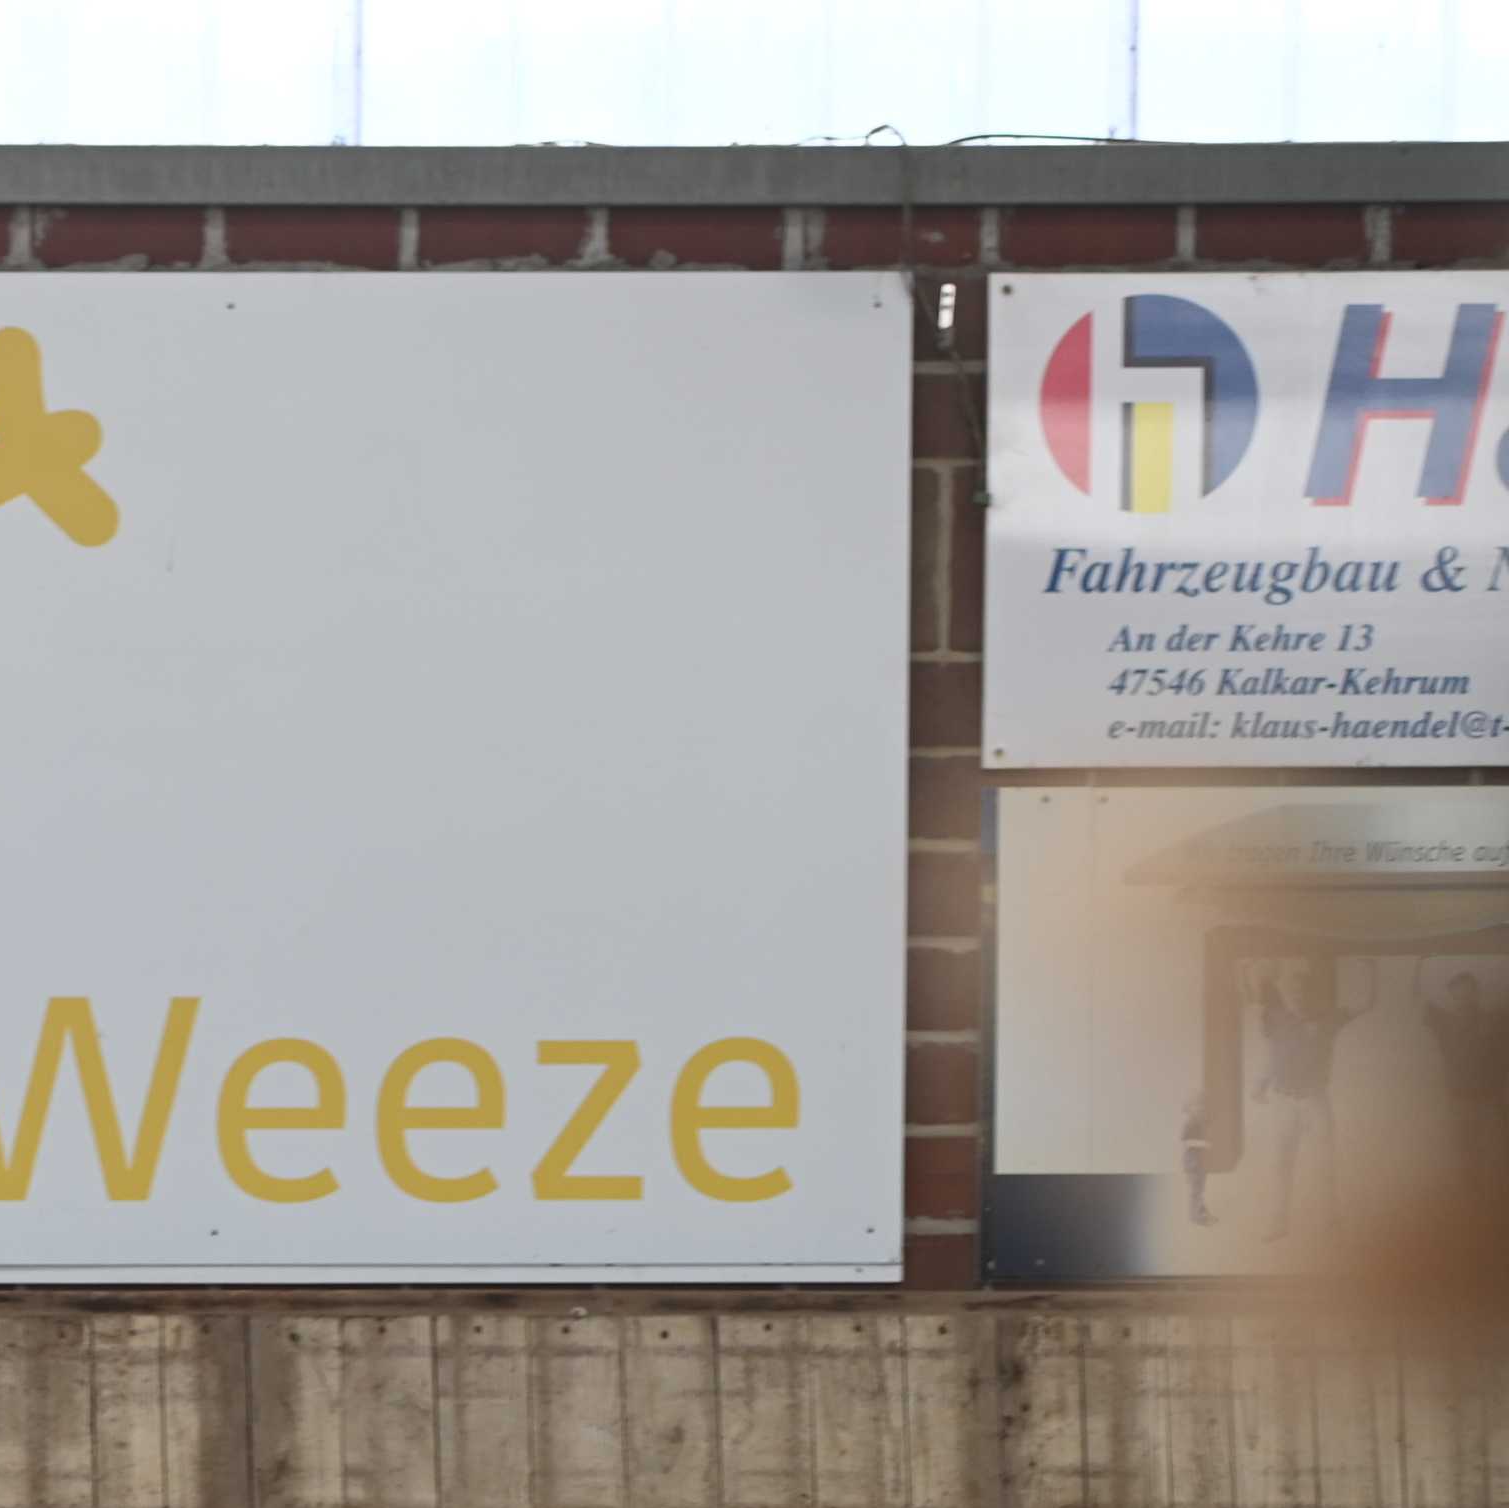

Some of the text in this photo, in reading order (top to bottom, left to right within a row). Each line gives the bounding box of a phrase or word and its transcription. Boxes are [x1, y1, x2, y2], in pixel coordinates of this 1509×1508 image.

[1303, 303, 1509, 507] H
[1042, 546, 1399, 606] Fahrzeugbau
[1420, 545, 1467, 593] &
[1107, 625, 1375, 653] An der Kehre 13
[1106, 668, 1470, 696] 47546 Kalkar-Kehrum
[1107, 713, 1221, 740] e-mail:
